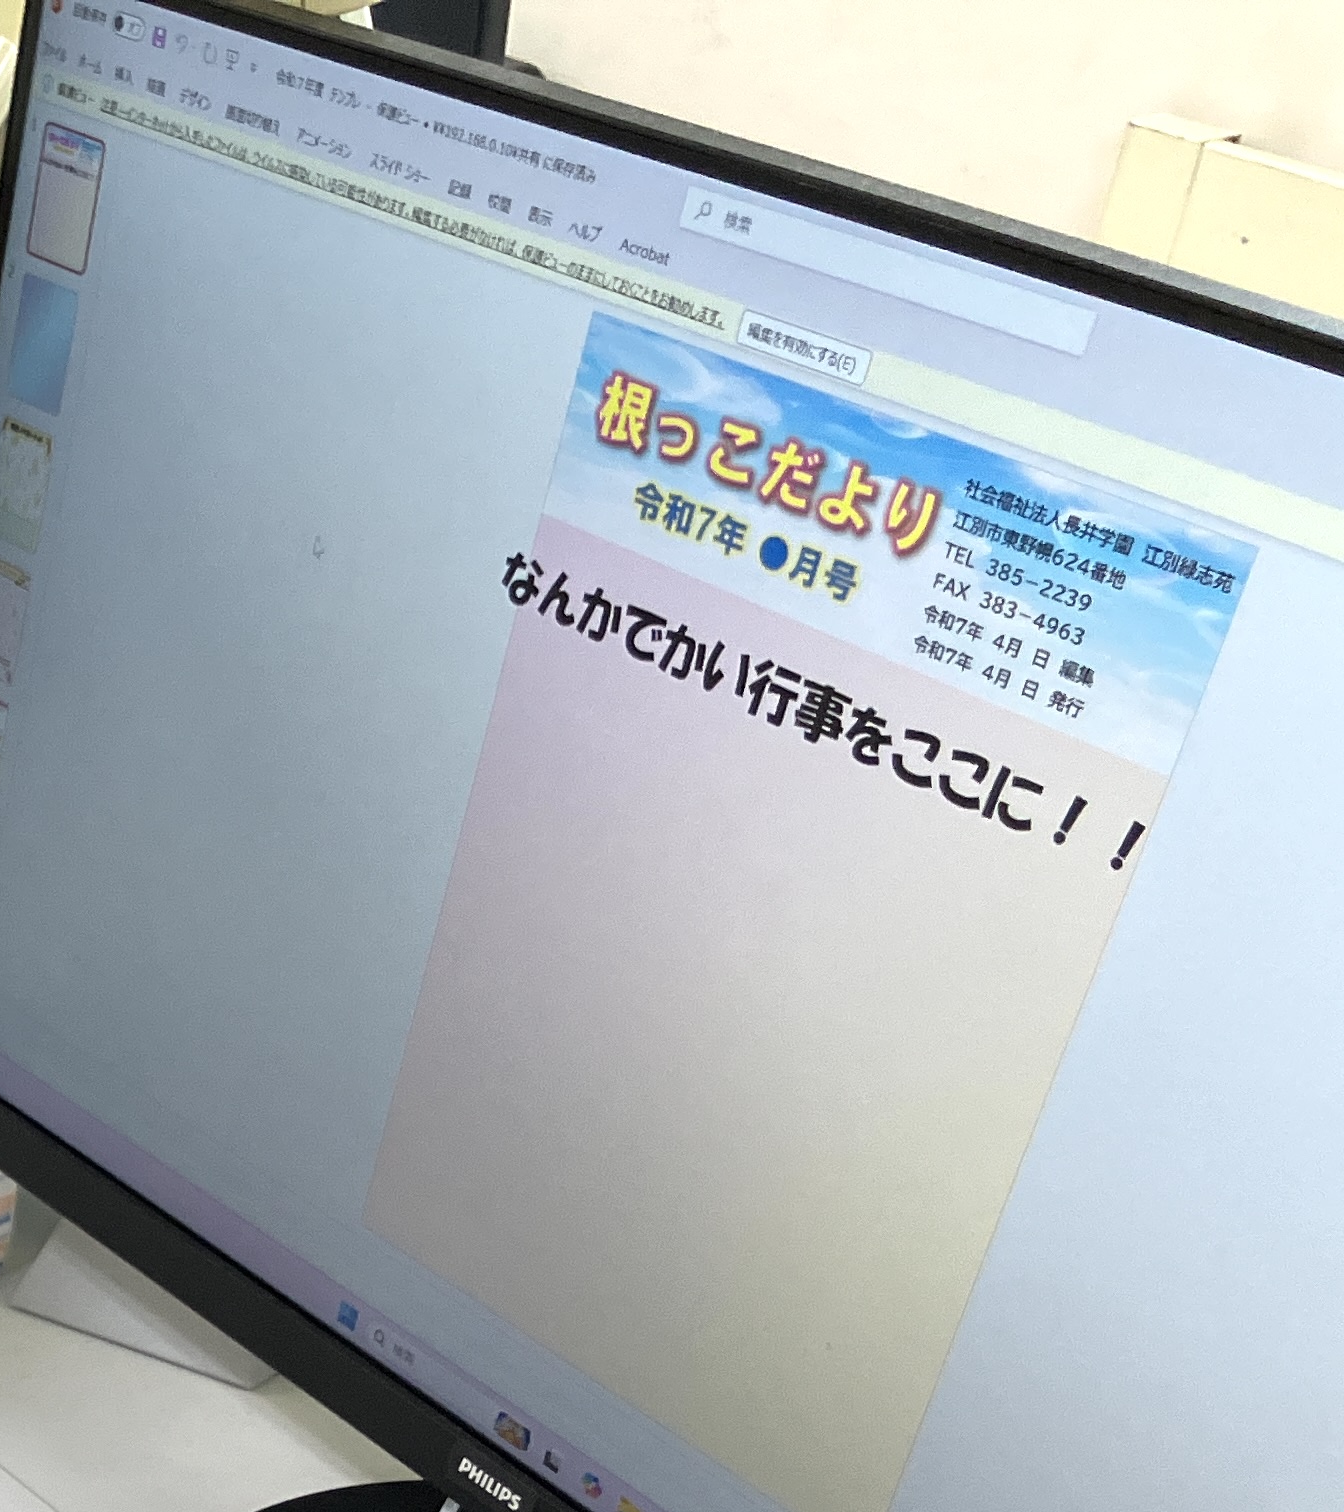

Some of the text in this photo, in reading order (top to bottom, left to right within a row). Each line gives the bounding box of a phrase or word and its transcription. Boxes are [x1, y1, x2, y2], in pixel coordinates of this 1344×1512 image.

[527, 205, 554, 226] 表示
[568, 222, 603, 242] ヘルプ
[618, 238, 671, 267] Acrobat
[723, 210, 753, 236] 検索
[747, 322, 857, 376] 編集を有効にする(E)
[596, 370, 943, 556] 根っこだより
[634, 482, 749, 556] 令和7年
[952, 509, 1127, 590] 江別市東野幌624番地
[964, 478, 1135, 556] 社会福祉法人長井学園
[932, 572, 972, 601] FAX
[944, 541, 974, 569] TEL
[913, 635, 1085, 719] 令和7年 4月 日 発行
[924, 604, 1094, 688] 令和7年 4月 日 編集
[458, 1458, 521, 1512] PHILIPS
